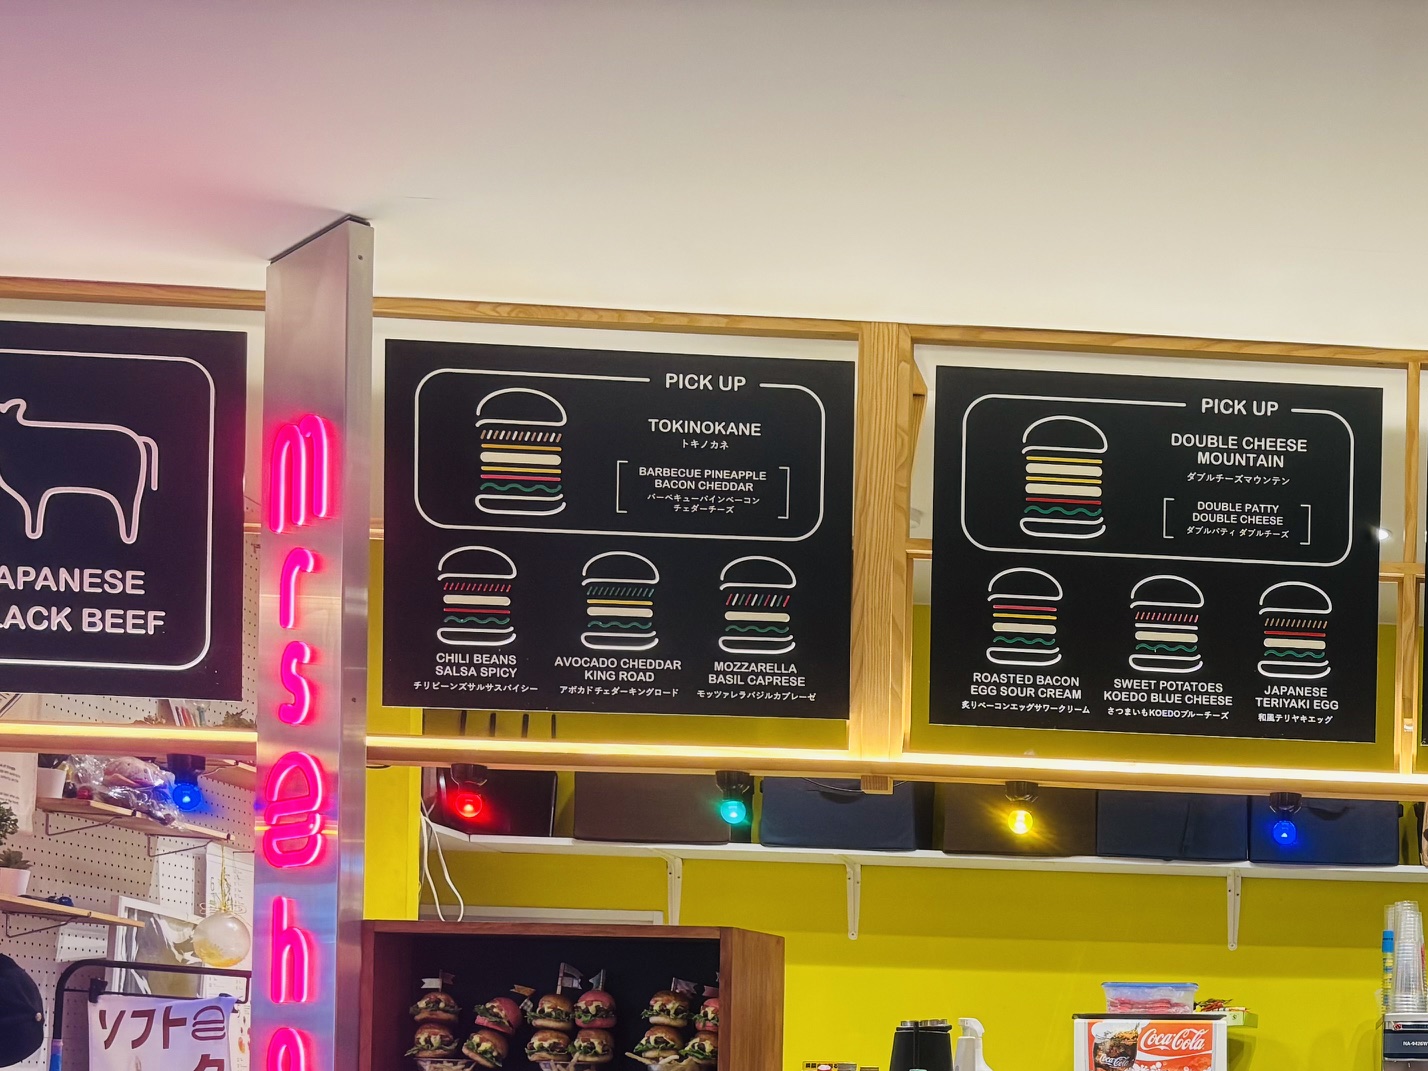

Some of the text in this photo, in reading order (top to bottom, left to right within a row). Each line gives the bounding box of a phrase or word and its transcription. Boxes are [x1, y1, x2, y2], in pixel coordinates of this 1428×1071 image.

[665, 374, 746, 392] PICK UP
[1201, 398, 1279, 416] PICK UP
[648, 419, 761, 436] TOKINOKANE
[682, 439, 729, 450] トキノカネ
[1171, 433, 1307, 452] DOUBLE CHEESE
[1198, 452, 1284, 468] MOUNTAIN
[639, 467, 766, 480] BARBECUE PINEAPPLE
[1187, 472, 1290, 485] ダブルチーズマウンテン
[654, 480, 753, 492] BACON CHEDDAR
[673, 504, 734, 514] チェダーチーズ
[1197, 502, 1279, 514] DOUBLE PATTY
[1192, 512, 1283, 525] DOUBLE CHEESE
[82, 608, 166, 635] BEEF
[436, 653, 517, 665] CHILI BEANS
[554, 656, 682, 670] AVOCADO CHEDDAR
[435, 665, 518, 678] SALSA SPICY
[714, 661, 797, 674] MOZZARELLA
[584, 670, 655, 682] KING ROAD
[708, 674, 806, 687] BASIL CAPRESE
[973, 672, 1080, 687] ROASTED BACON
[970, 685, 1082, 700] EGG SOUR CREAM
[1114, 679, 1223, 694] SWEET POTATOES
[1264, 685, 1328, 698] JAPANESE
[1103, 692, 1233, 707] KOEDO BLUE CHEESE
[1255, 697, 1339, 711] TERIYAKI EGG
[1258, 713, 1333, 725] 和風テリヤキエッグ
[98, 1006, 188, 1051] ソフト
